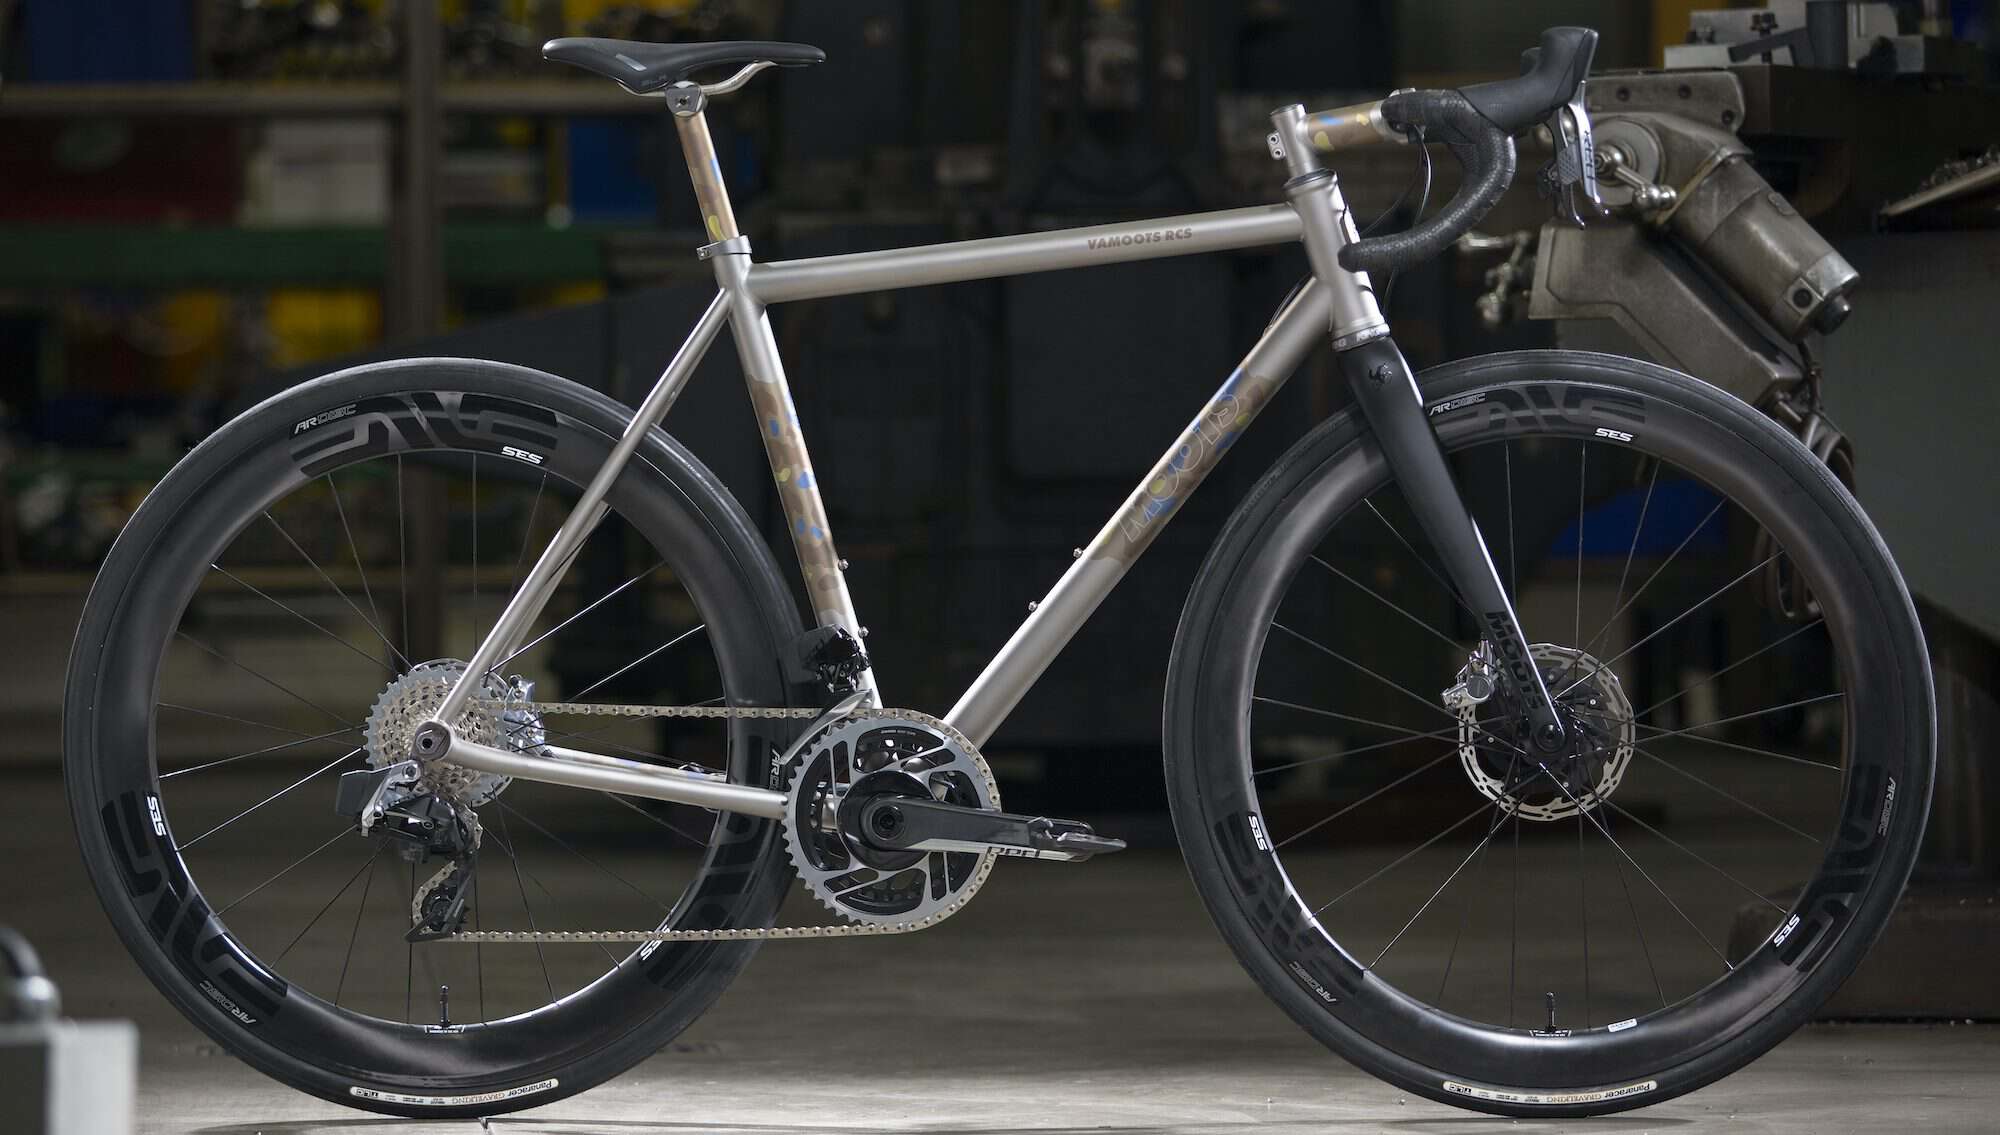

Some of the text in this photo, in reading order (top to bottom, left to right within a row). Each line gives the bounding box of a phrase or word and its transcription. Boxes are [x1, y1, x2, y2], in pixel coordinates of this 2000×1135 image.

[1087, 228, 1192, 250] VAMOOTS RCS
[1595, 427, 1633, 442] SES
[501, 446, 543, 465] SES
[1117, 393, 1240, 543] MOOTS
[1484, 611, 1545, 709] MOOTS
[147, 796, 166, 837] SES
[1248, 815, 1268, 851] SES
[1774, 914, 1800, 947] SES
[508, 1081, 552, 1097] Panaracer
[1604, 1083, 1650, 1098] Panaracer
